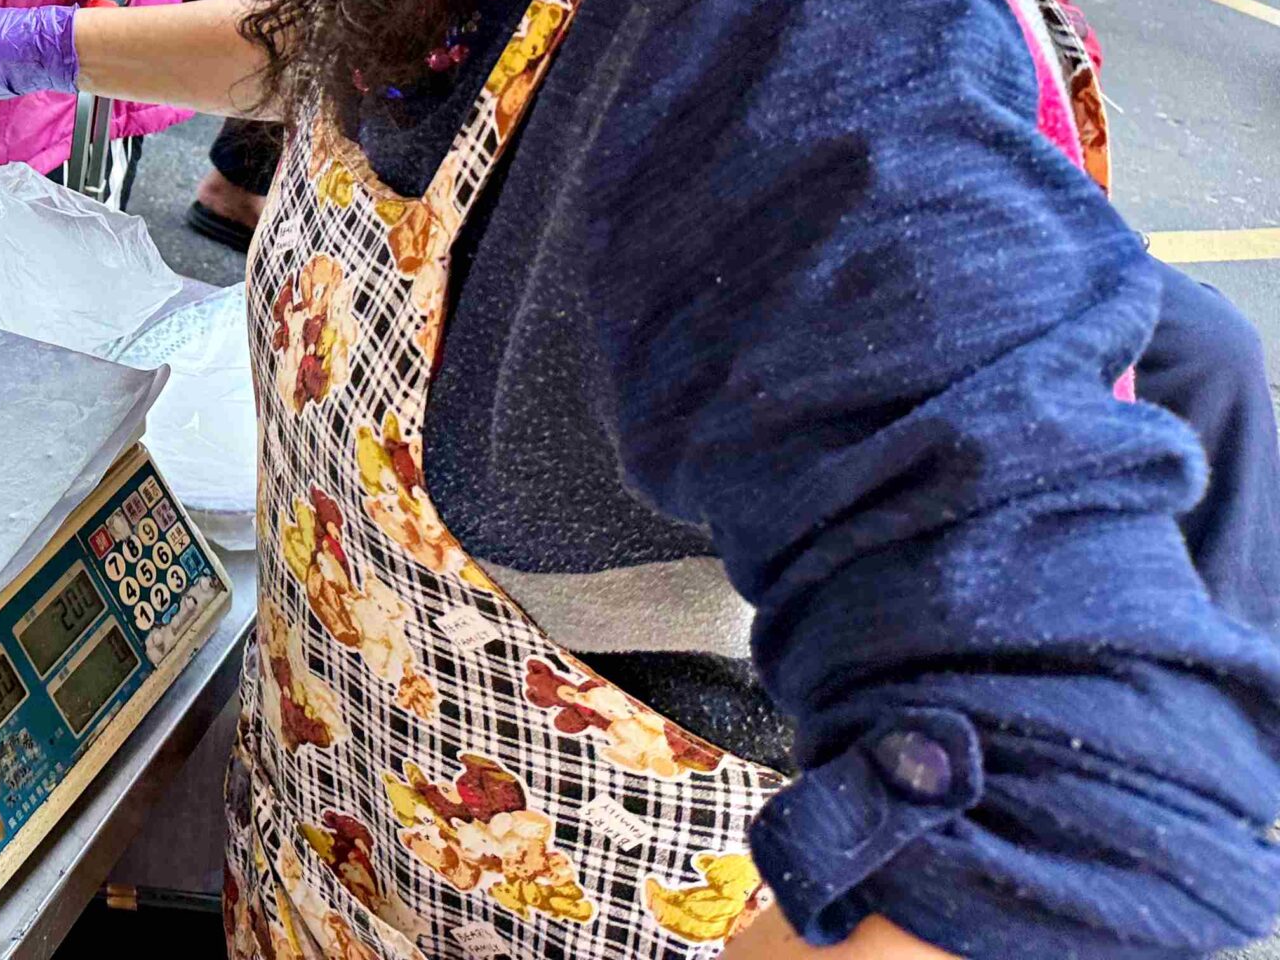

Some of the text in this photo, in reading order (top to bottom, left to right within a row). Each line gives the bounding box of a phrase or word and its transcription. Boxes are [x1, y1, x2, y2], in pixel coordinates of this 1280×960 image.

[142, 523, 155, 540] 9
[127, 538, 139, 559] 8
[157, 546, 169, 565] 6
[108, 556, 120, 576] 7
[140, 562, 153, 579] 5
[171, 571, 183, 589] 3
[125, 581, 138, 601] 4
[154, 589, 168, 610] 2
[139, 605, 151, 624] 1
